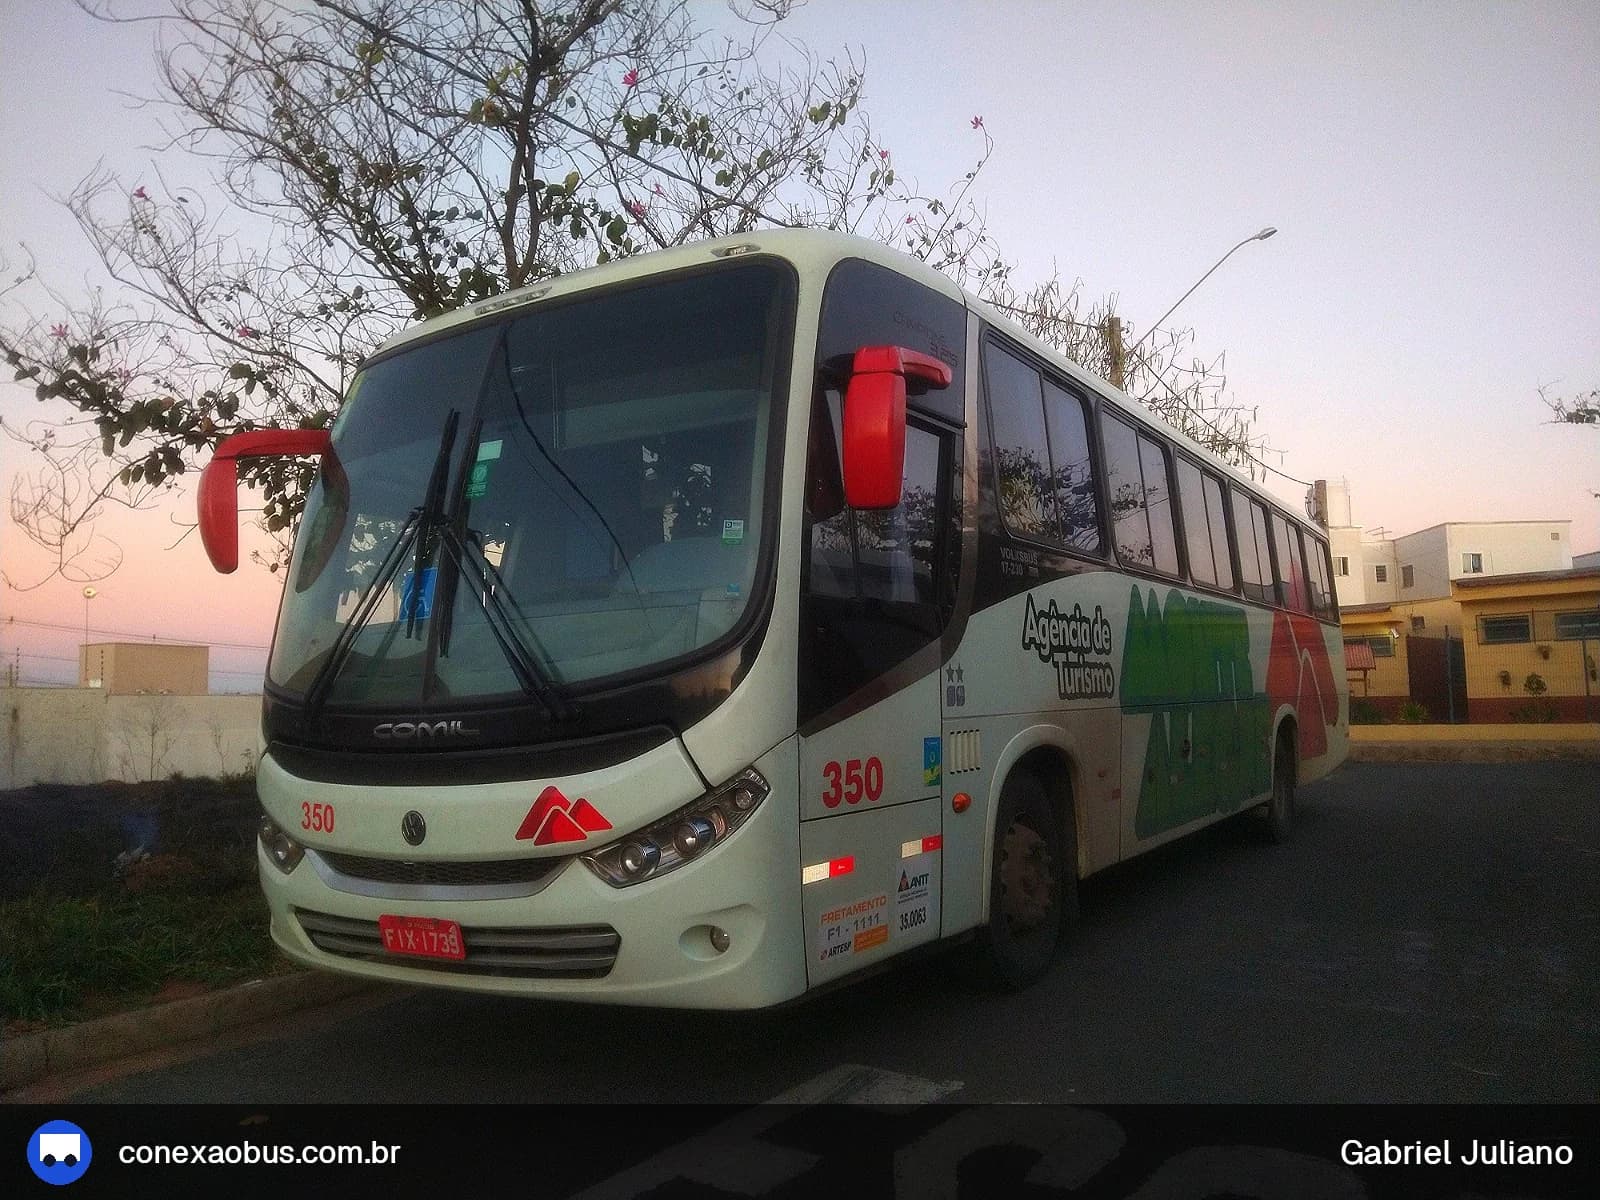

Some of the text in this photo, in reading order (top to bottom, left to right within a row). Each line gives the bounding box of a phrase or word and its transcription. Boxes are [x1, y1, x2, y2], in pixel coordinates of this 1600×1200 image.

[1000, 546, 1038, 565] VOLKSBUS
[1022, 593, 1112, 663] Agência de
[1052, 653, 1114, 699] Turismo
[373, 720, 480, 738] COMIL
[822, 756, 884, 808] 350
[301, 802, 334, 833] 350
[910, 873, 929, 889] ANTT
[821, 896, 887, 925] FRETAMENTO
[828, 940, 852, 958] ARTESP
